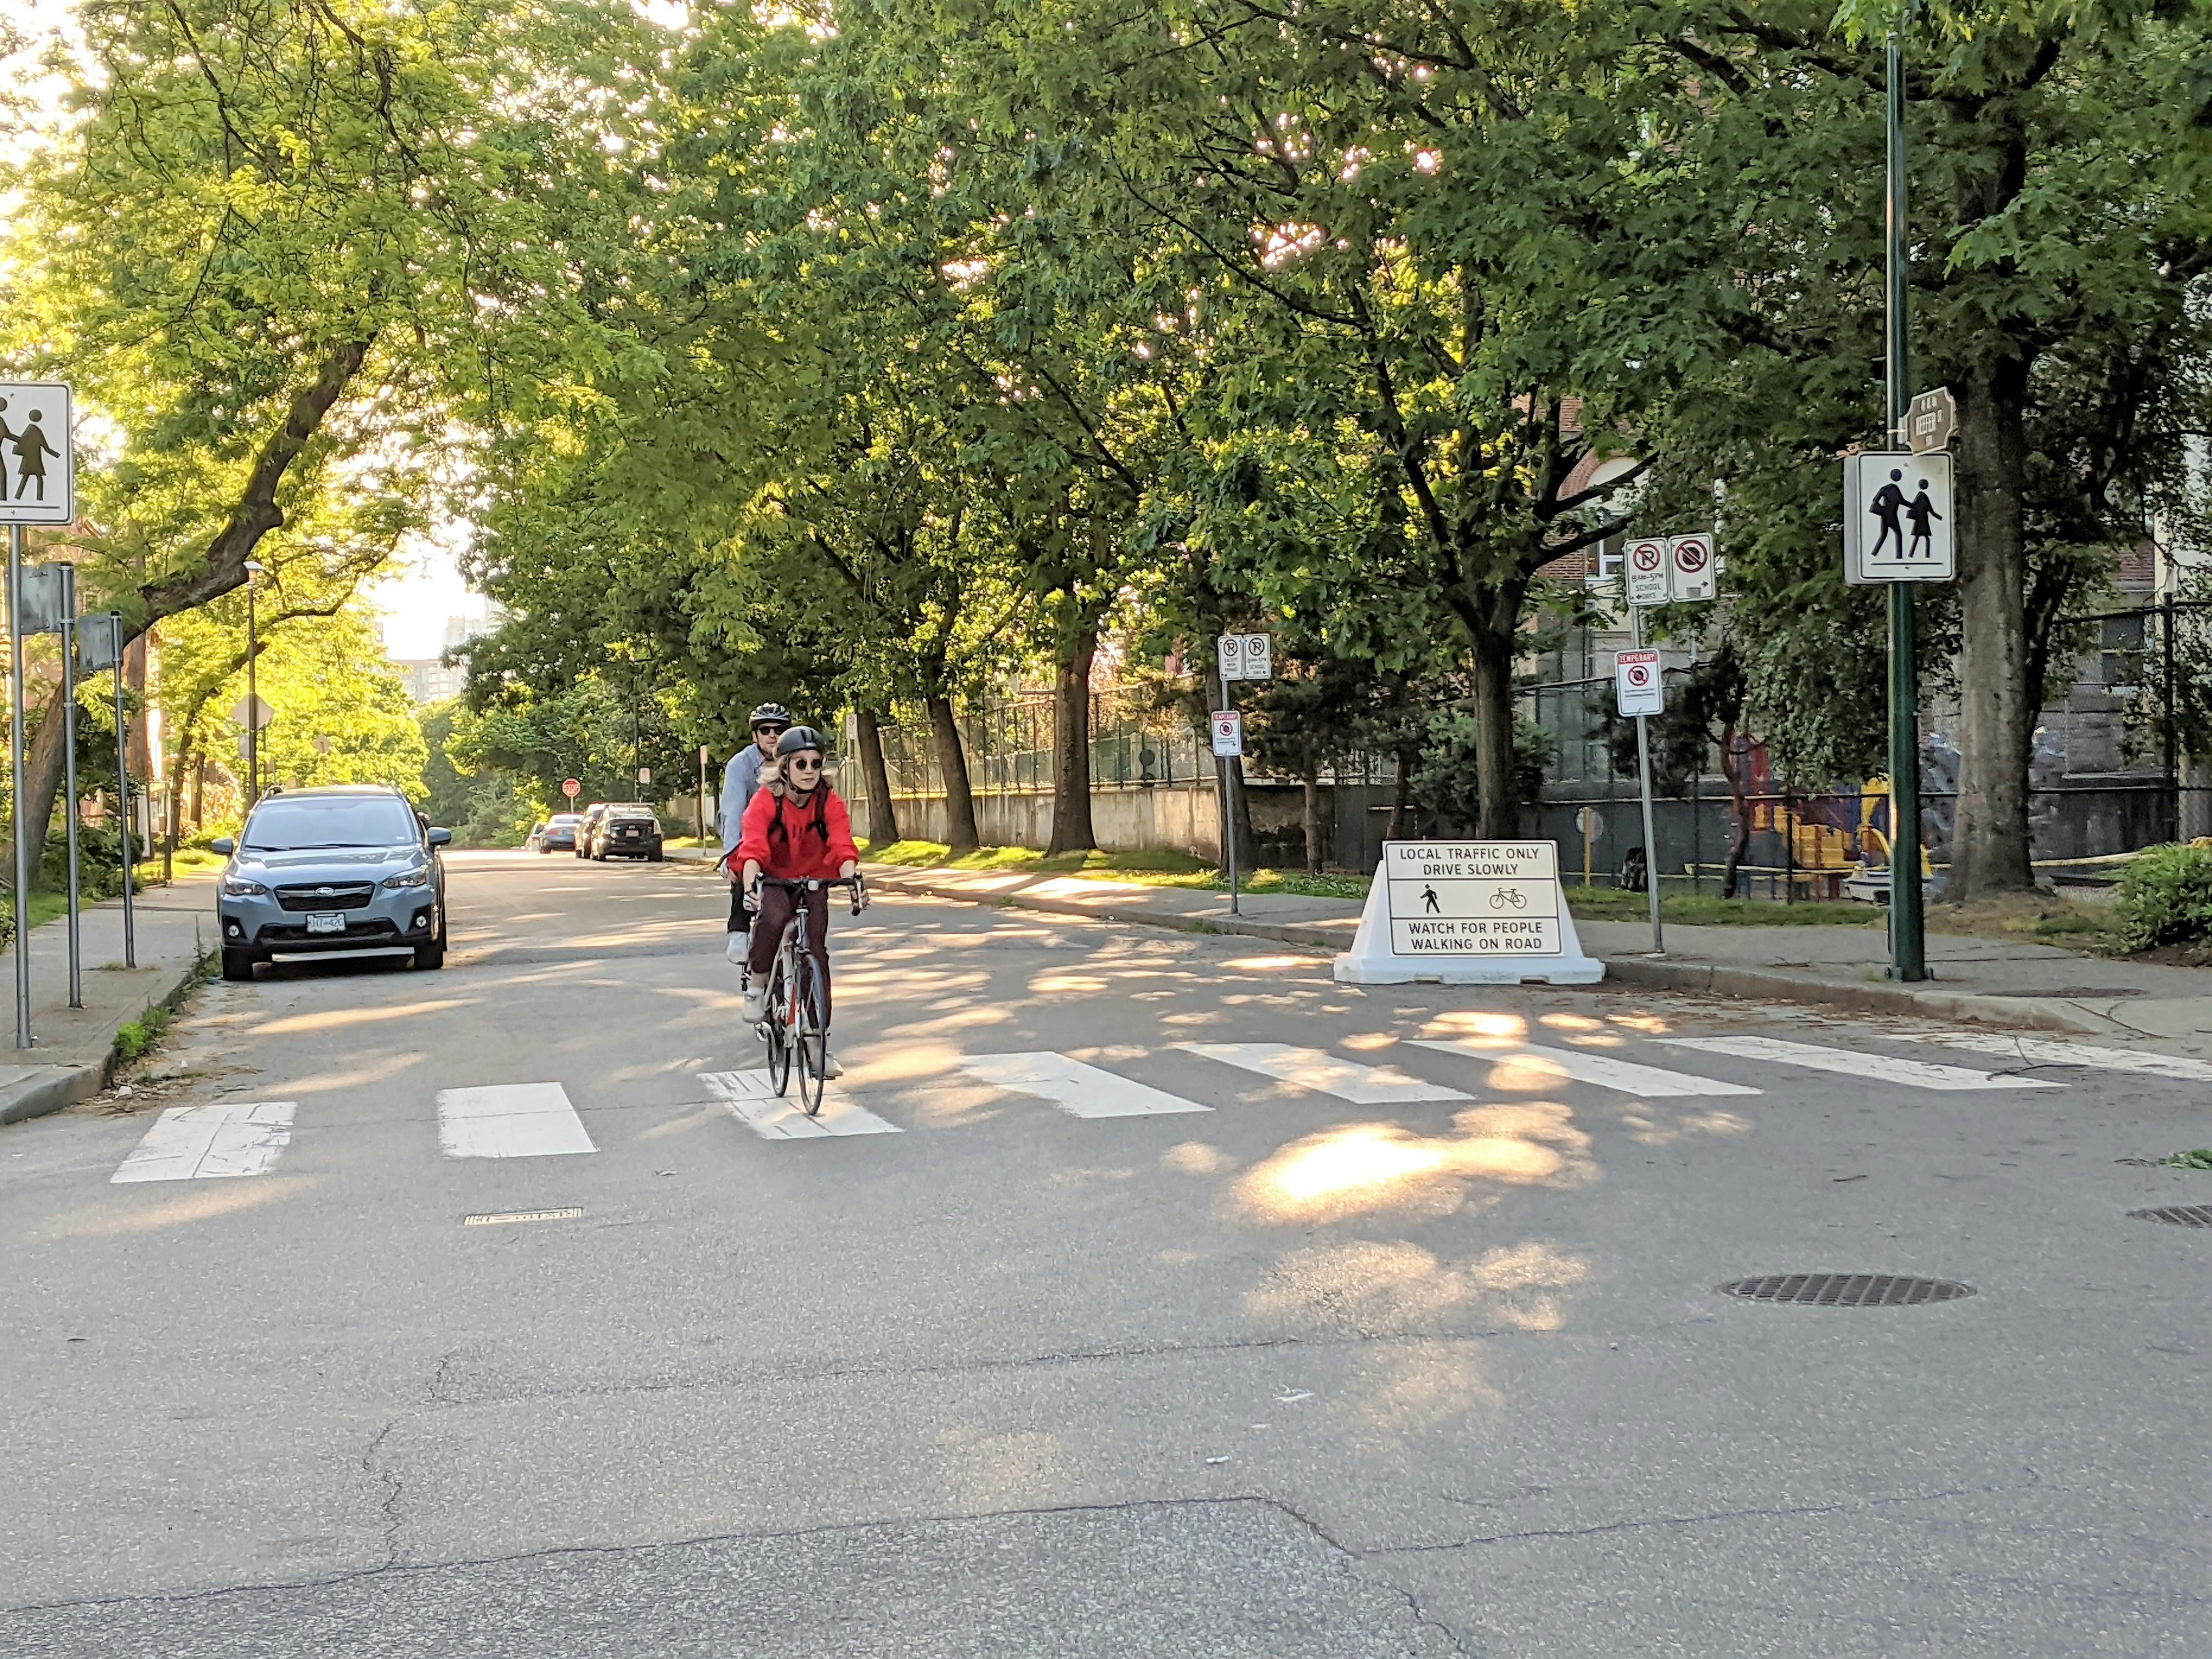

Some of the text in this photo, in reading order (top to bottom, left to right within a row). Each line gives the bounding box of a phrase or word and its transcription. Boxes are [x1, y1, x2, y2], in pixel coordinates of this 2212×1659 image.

[1400, 848, 1539, 860] LOCAL TRAFFIC ONLY
[1424, 864, 1518, 875] DRIVE SLOWLY
[1409, 922, 1542, 934] WATCH FOR PEOPLE
[1411, 938, 1542, 950] WALKING ON ROAD
